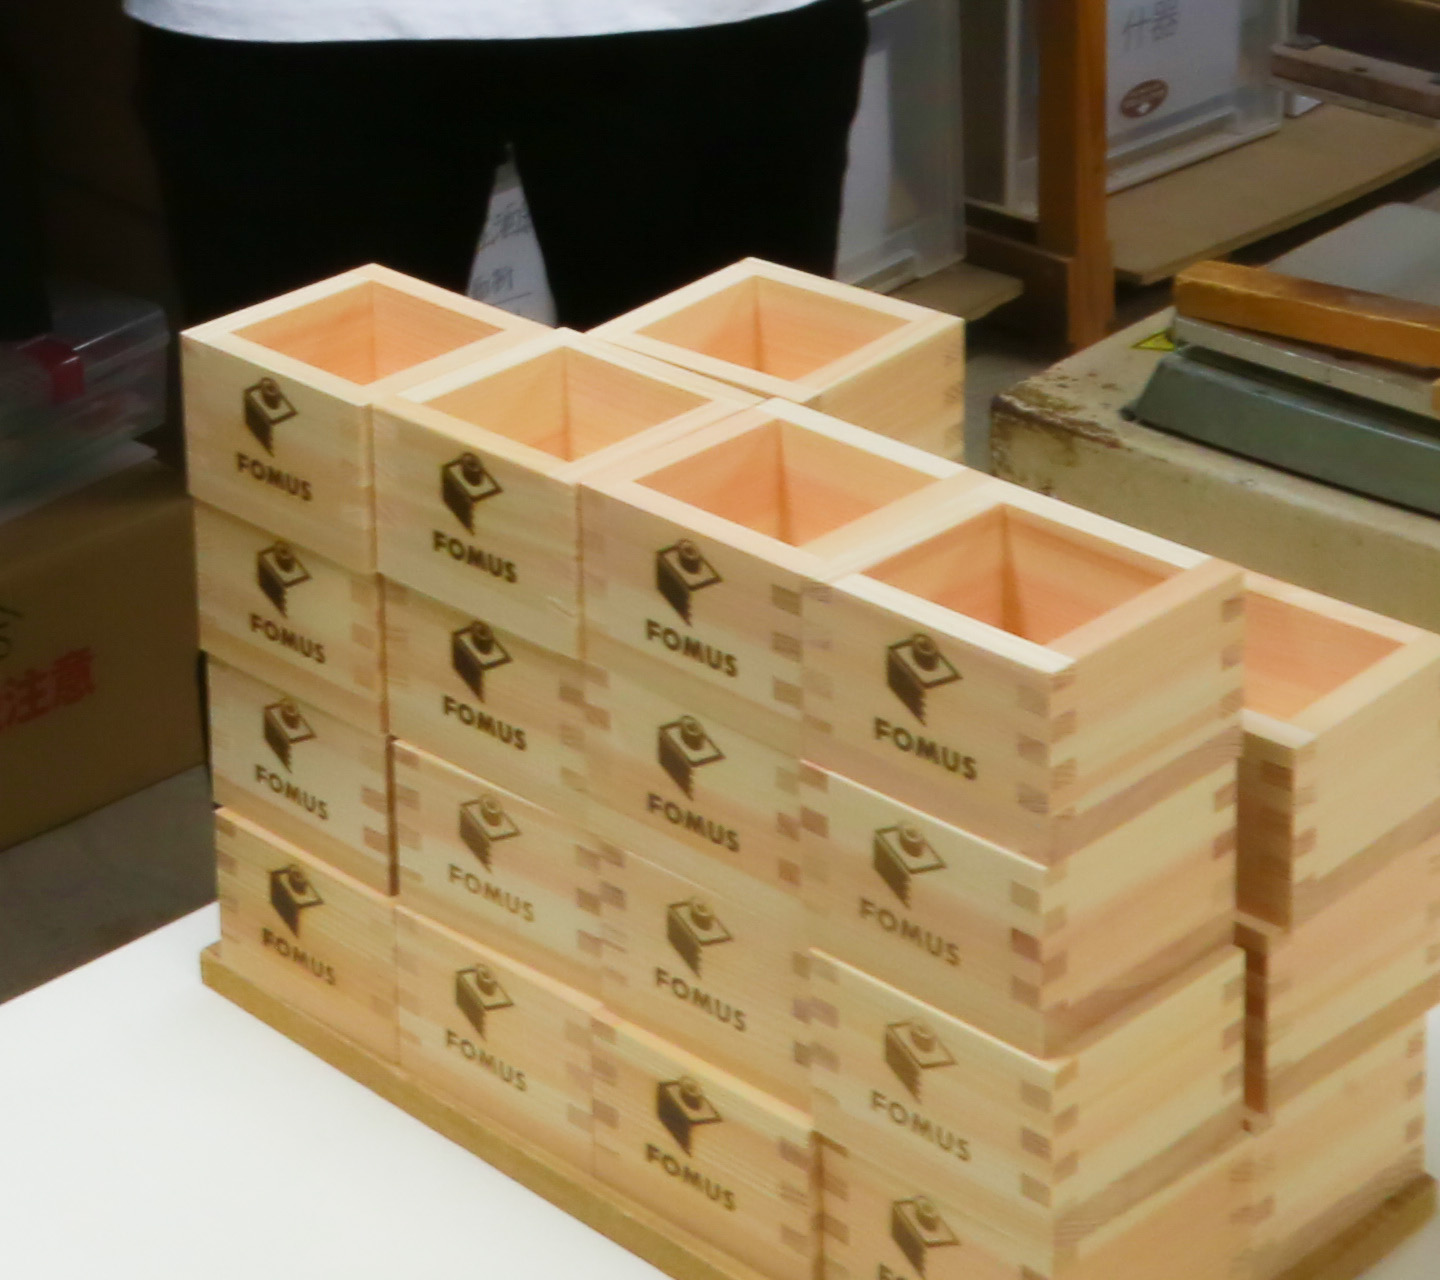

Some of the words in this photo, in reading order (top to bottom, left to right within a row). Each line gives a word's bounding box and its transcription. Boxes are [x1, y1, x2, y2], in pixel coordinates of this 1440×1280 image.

[236, 451, 313, 503] FOMUS
[432, 529, 517, 585] FOMUS
[249, 613, 327, 665] FOMUS
[645, 618, 739, 678] FOMUS
[442, 693, 528, 752] FOMUS
[872, 716, 980, 782] FOMUS
[255, 762, 329, 822] FOMUS
[646, 791, 741, 853] FOMUS
[447, 862, 534, 923] FOMUS
[261, 926, 337, 987] FOMUS
[858, 896, 962, 969] FOMUS
[654, 966, 748, 1033] FOMUS
[444, 1029, 528, 1094] FOMUS
[869, 1090, 972, 1165] FOMUS
[643, 1141, 737, 1212] FOMUS
